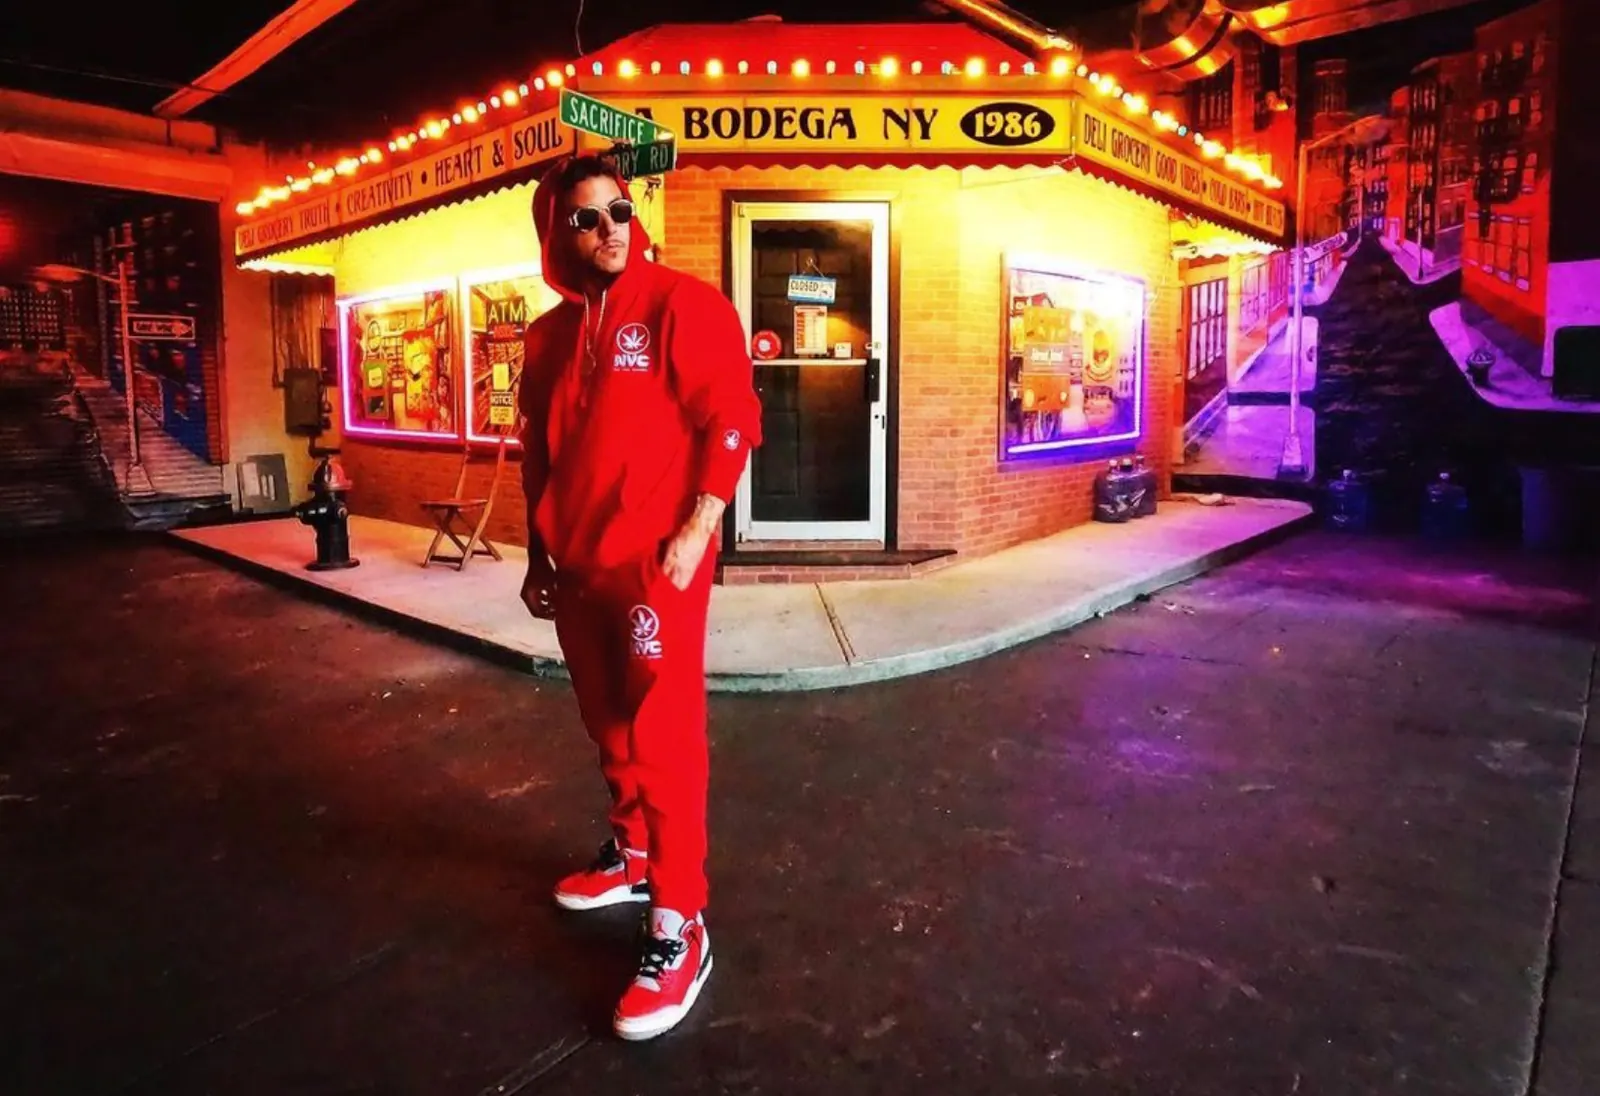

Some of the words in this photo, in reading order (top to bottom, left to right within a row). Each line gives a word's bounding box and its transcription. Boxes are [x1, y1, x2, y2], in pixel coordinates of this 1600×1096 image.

[569, 96, 645, 148] SACRIFICE
[682, 107, 857, 140] BODEGA
[883, 107, 938, 141] NY
[973, 111, 1042, 138] 1986
[1083, 113, 1107, 153] DELI
[346, 170, 414, 214] CREATIVITY
[435, 145, 483, 187] HEART
[492, 139, 504, 168] &
[513, 117, 562, 161] SOUL
[649, 143, 669, 172] RD
[790, 280, 819, 293] CLOSED
[487, 299, 524, 324] ATM
